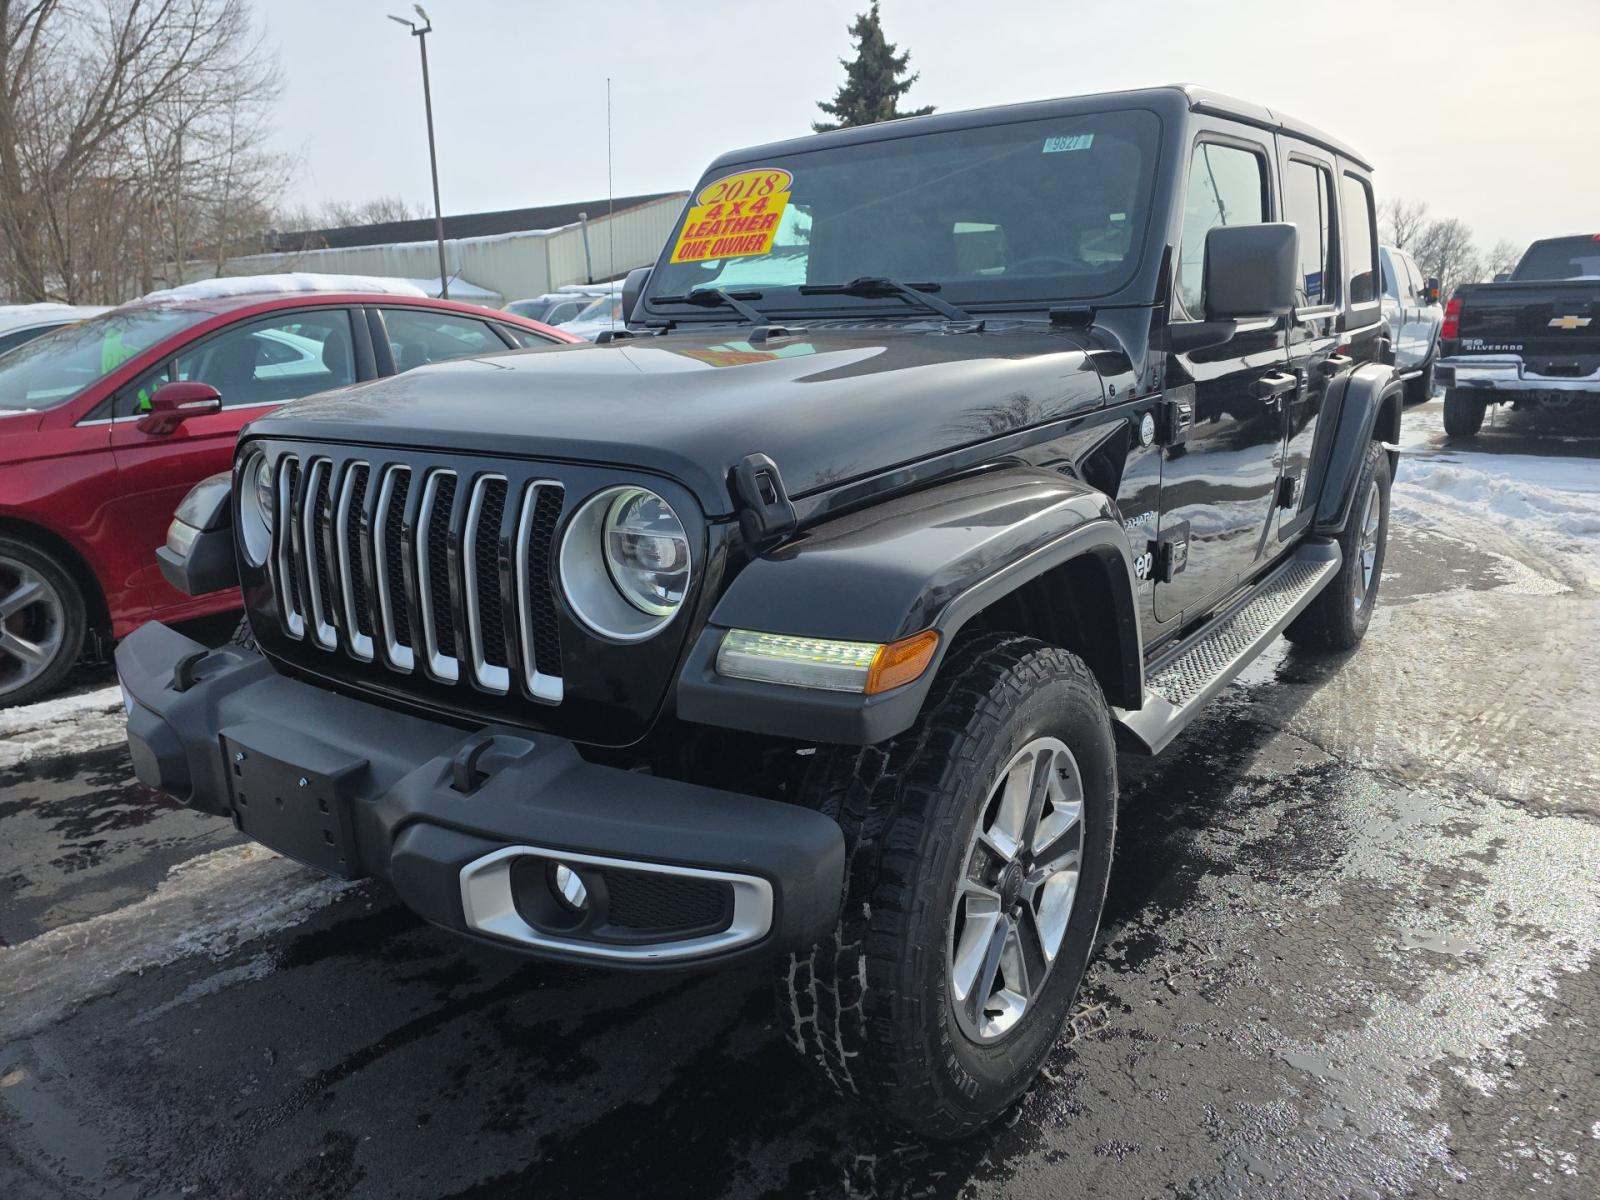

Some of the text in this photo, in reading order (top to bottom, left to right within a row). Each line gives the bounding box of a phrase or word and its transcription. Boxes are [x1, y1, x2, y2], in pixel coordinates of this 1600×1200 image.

[707, 173, 780, 204] 2018
[684, 213, 778, 240] LEATHER
[678, 233, 768, 261] ONE OWNER
